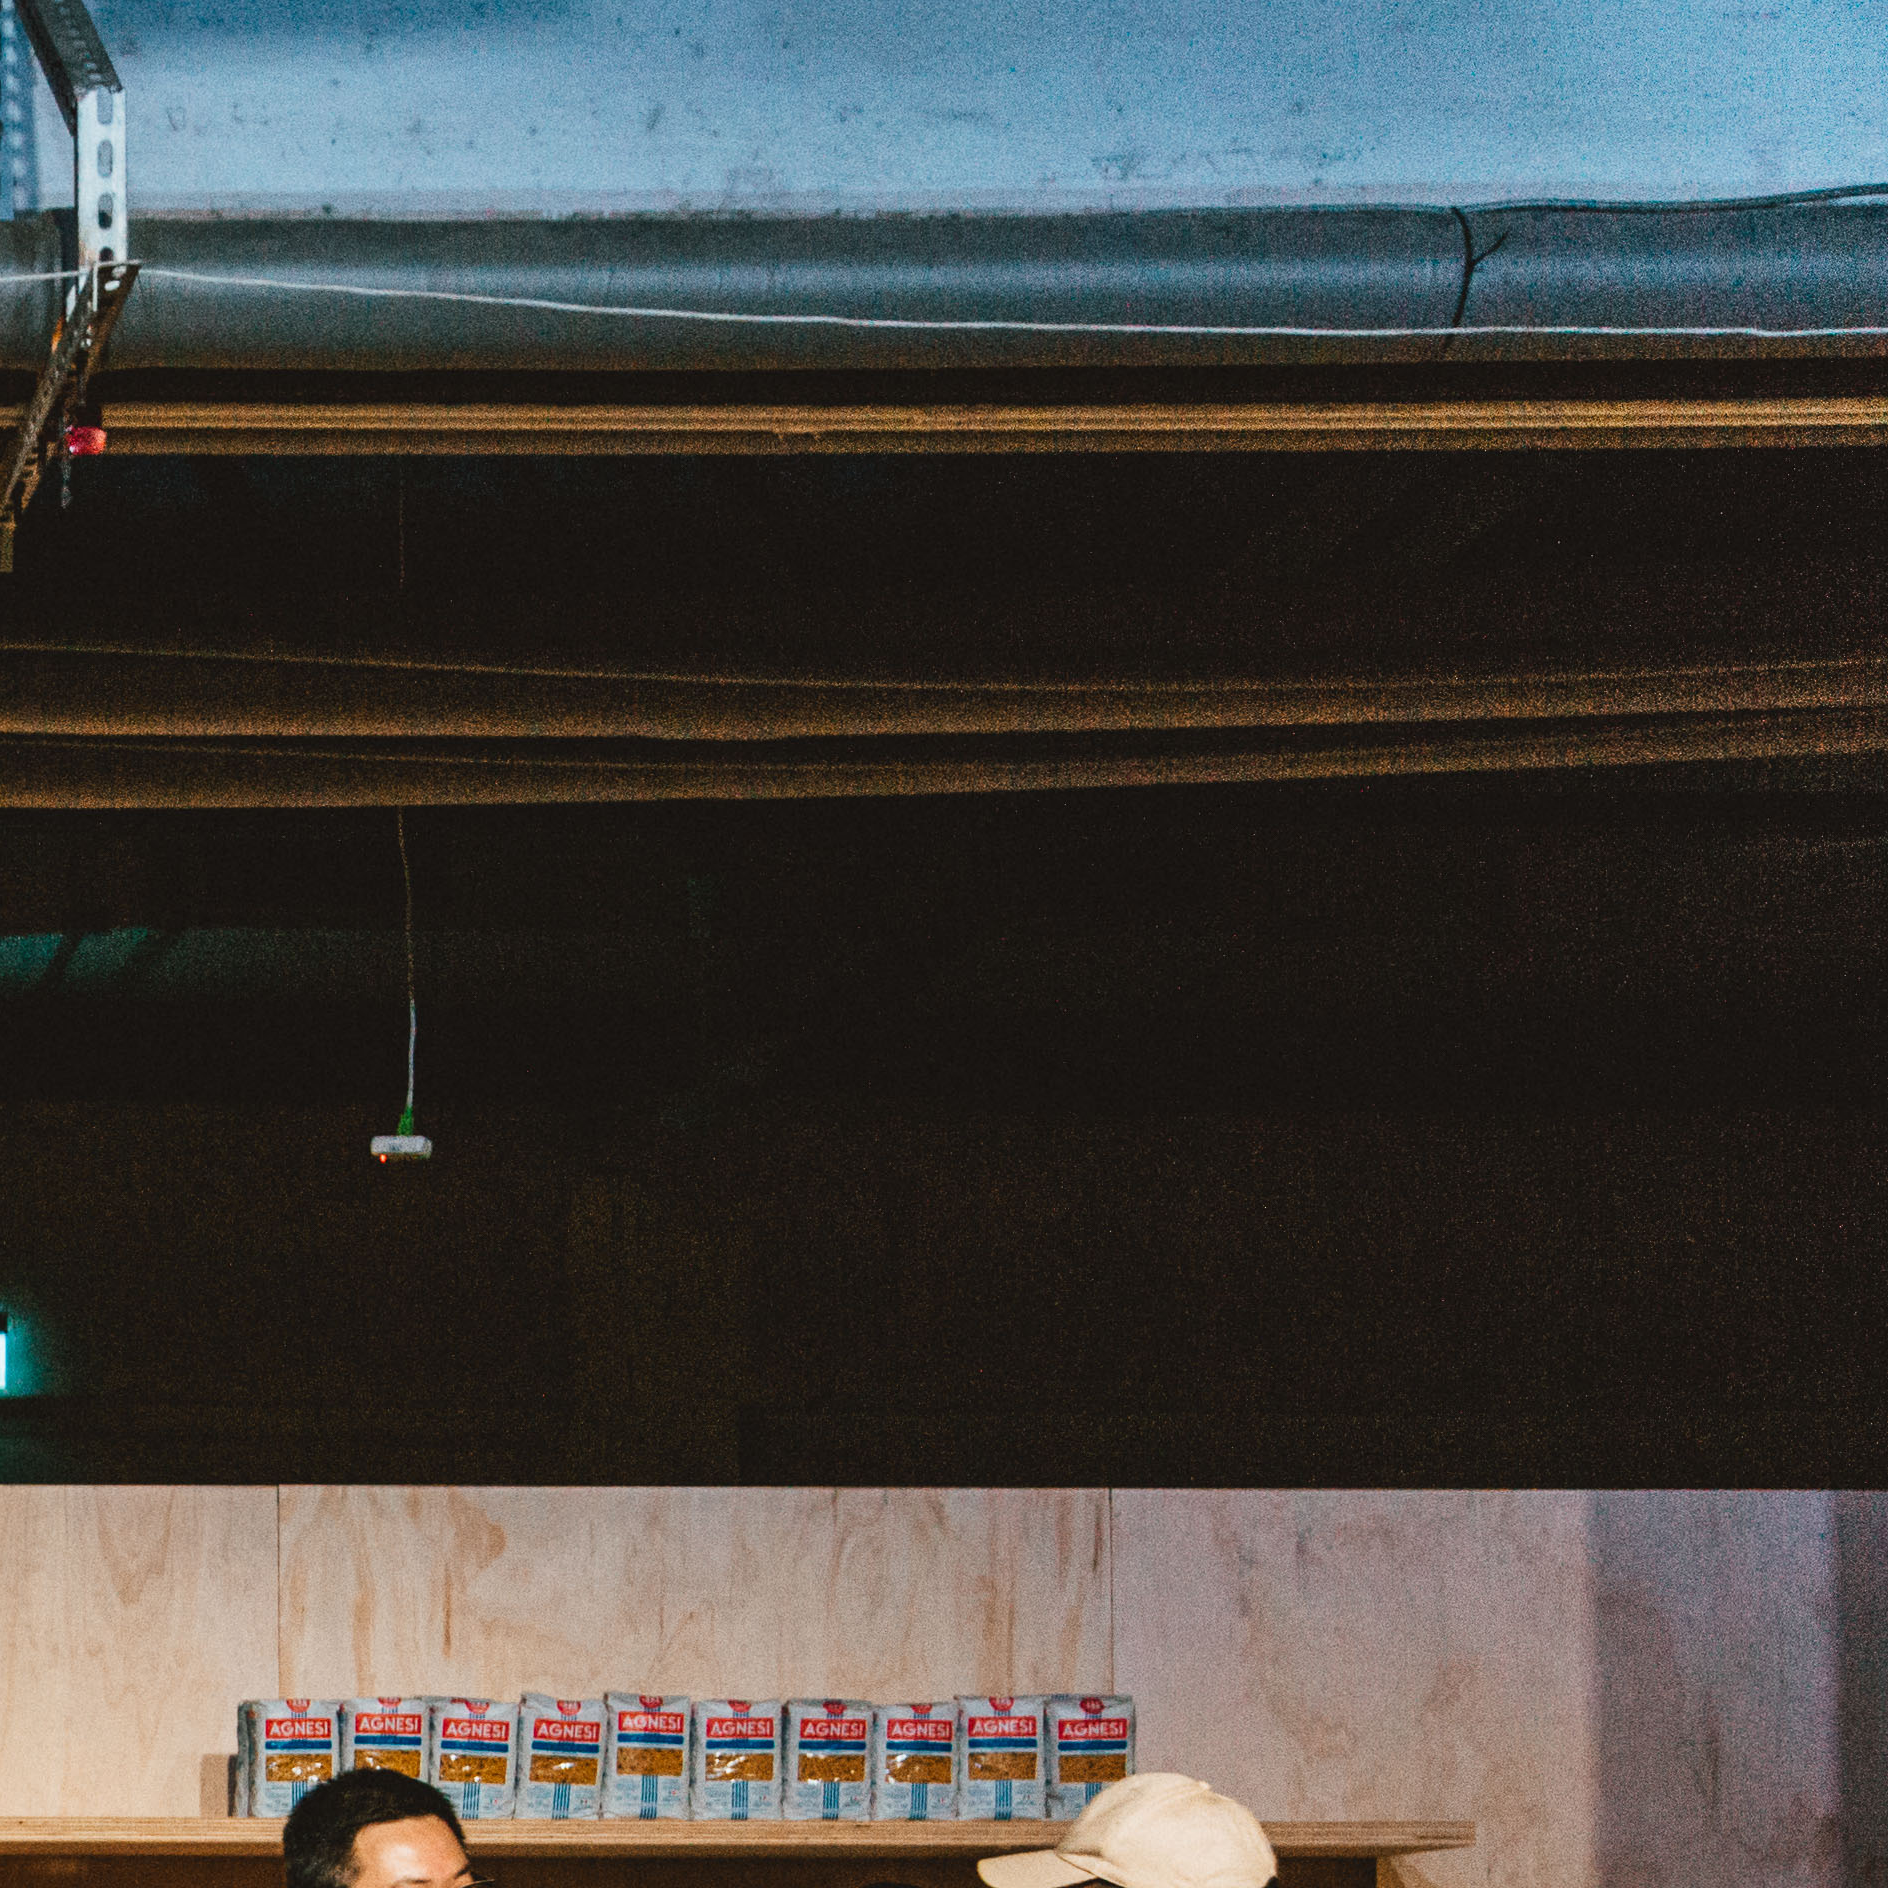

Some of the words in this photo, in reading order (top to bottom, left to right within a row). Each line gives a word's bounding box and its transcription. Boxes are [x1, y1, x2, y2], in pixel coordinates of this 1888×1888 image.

[269, 1720, 328, 1737] AGNESI
[359, 1716, 418, 1732] AGNESI
[446, 1722, 506, 1739] AGNESI
[537, 1722, 597, 1739] AGNESI
[623, 1714, 681, 1730] AGNESI
[711, 1720, 770, 1737] AGNESI
[804, 1721, 864, 1738] AGNESI
[892, 1721, 950, 1738] AGNESI
[972, 1719, 1034, 1736] AGNESI
[1062, 1721, 1123, 1738] AGNESI
